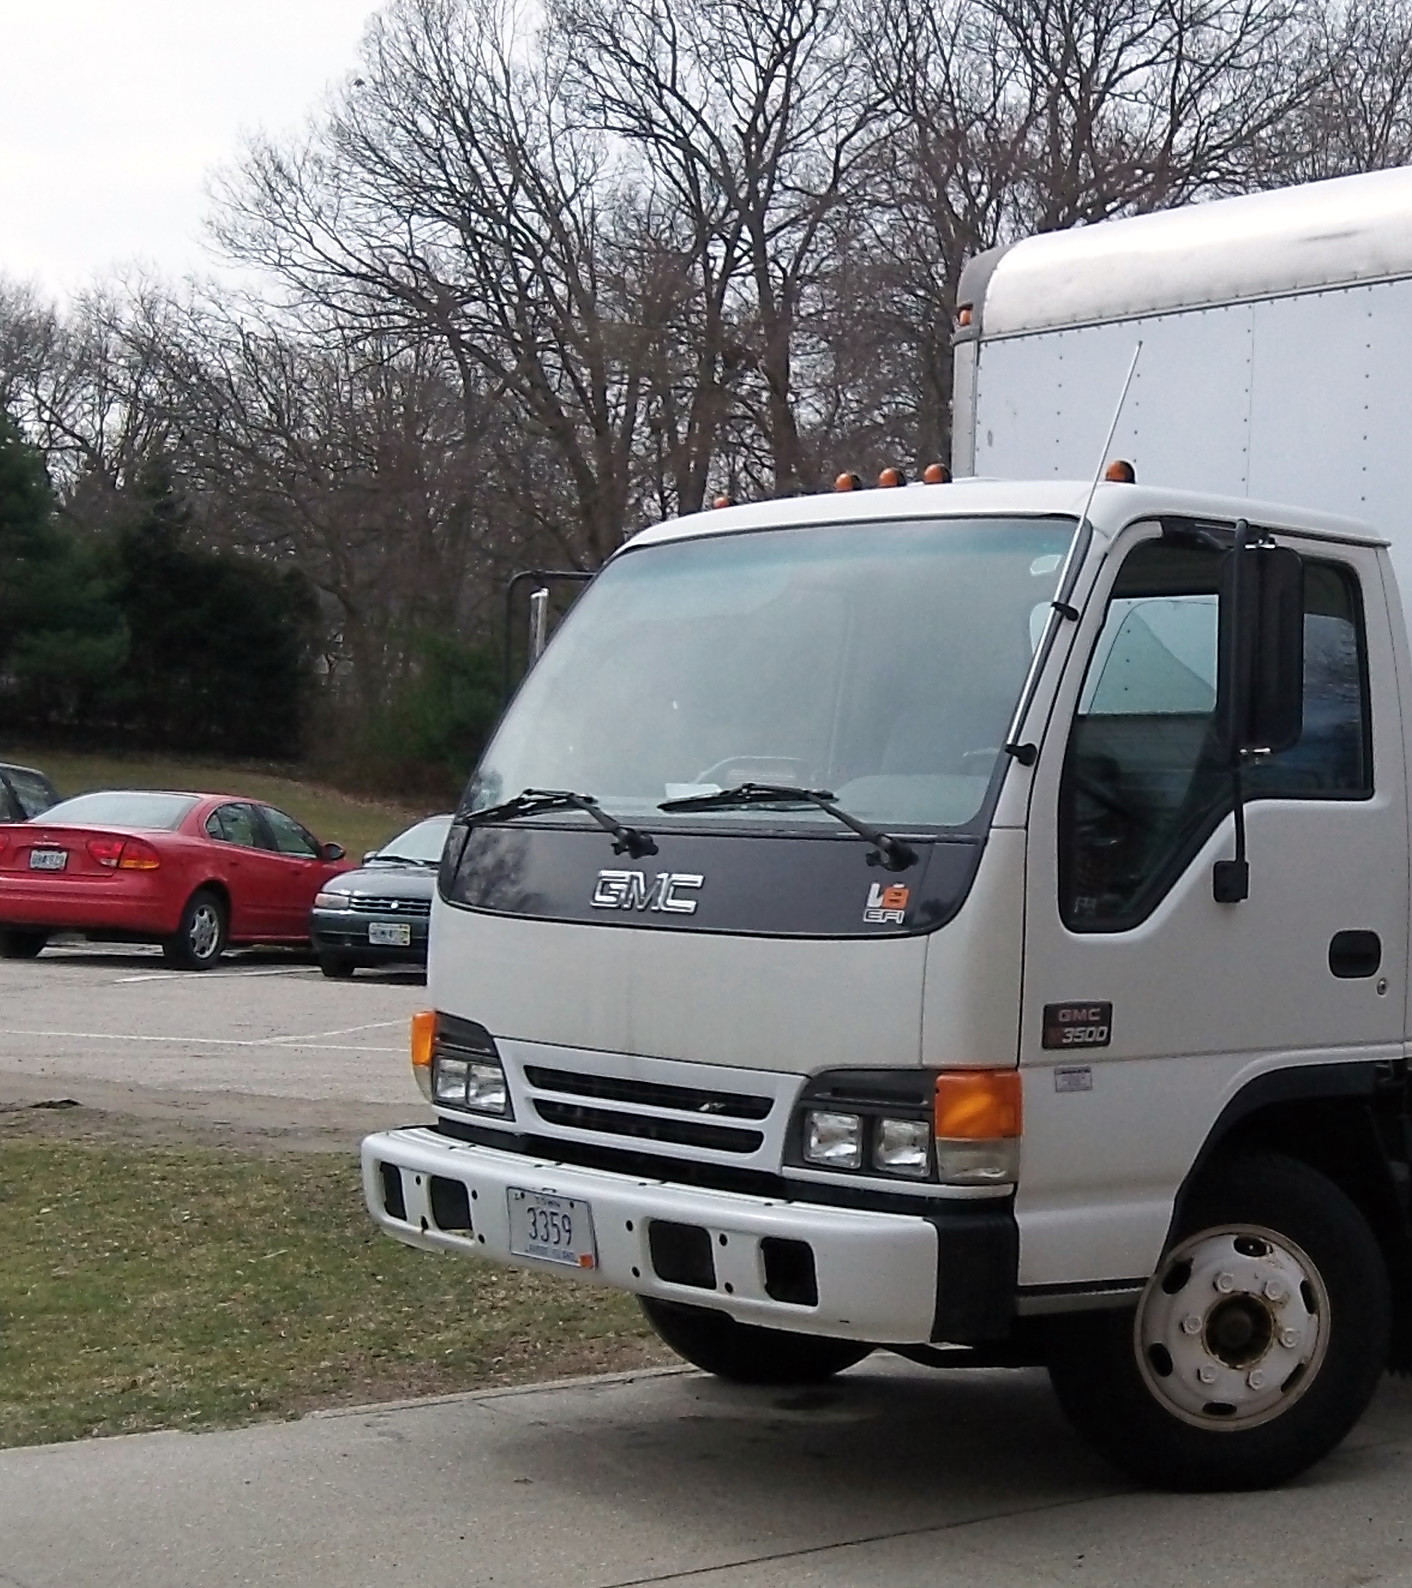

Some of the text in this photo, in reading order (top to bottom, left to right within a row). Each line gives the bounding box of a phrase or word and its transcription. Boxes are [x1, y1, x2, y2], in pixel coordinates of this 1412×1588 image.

[590, 869, 704, 914] GMC
[866, 882, 910, 909] V8
[1059, 1008, 1101, 1022] GMC
[527, 1207, 572, 1246] 3359
